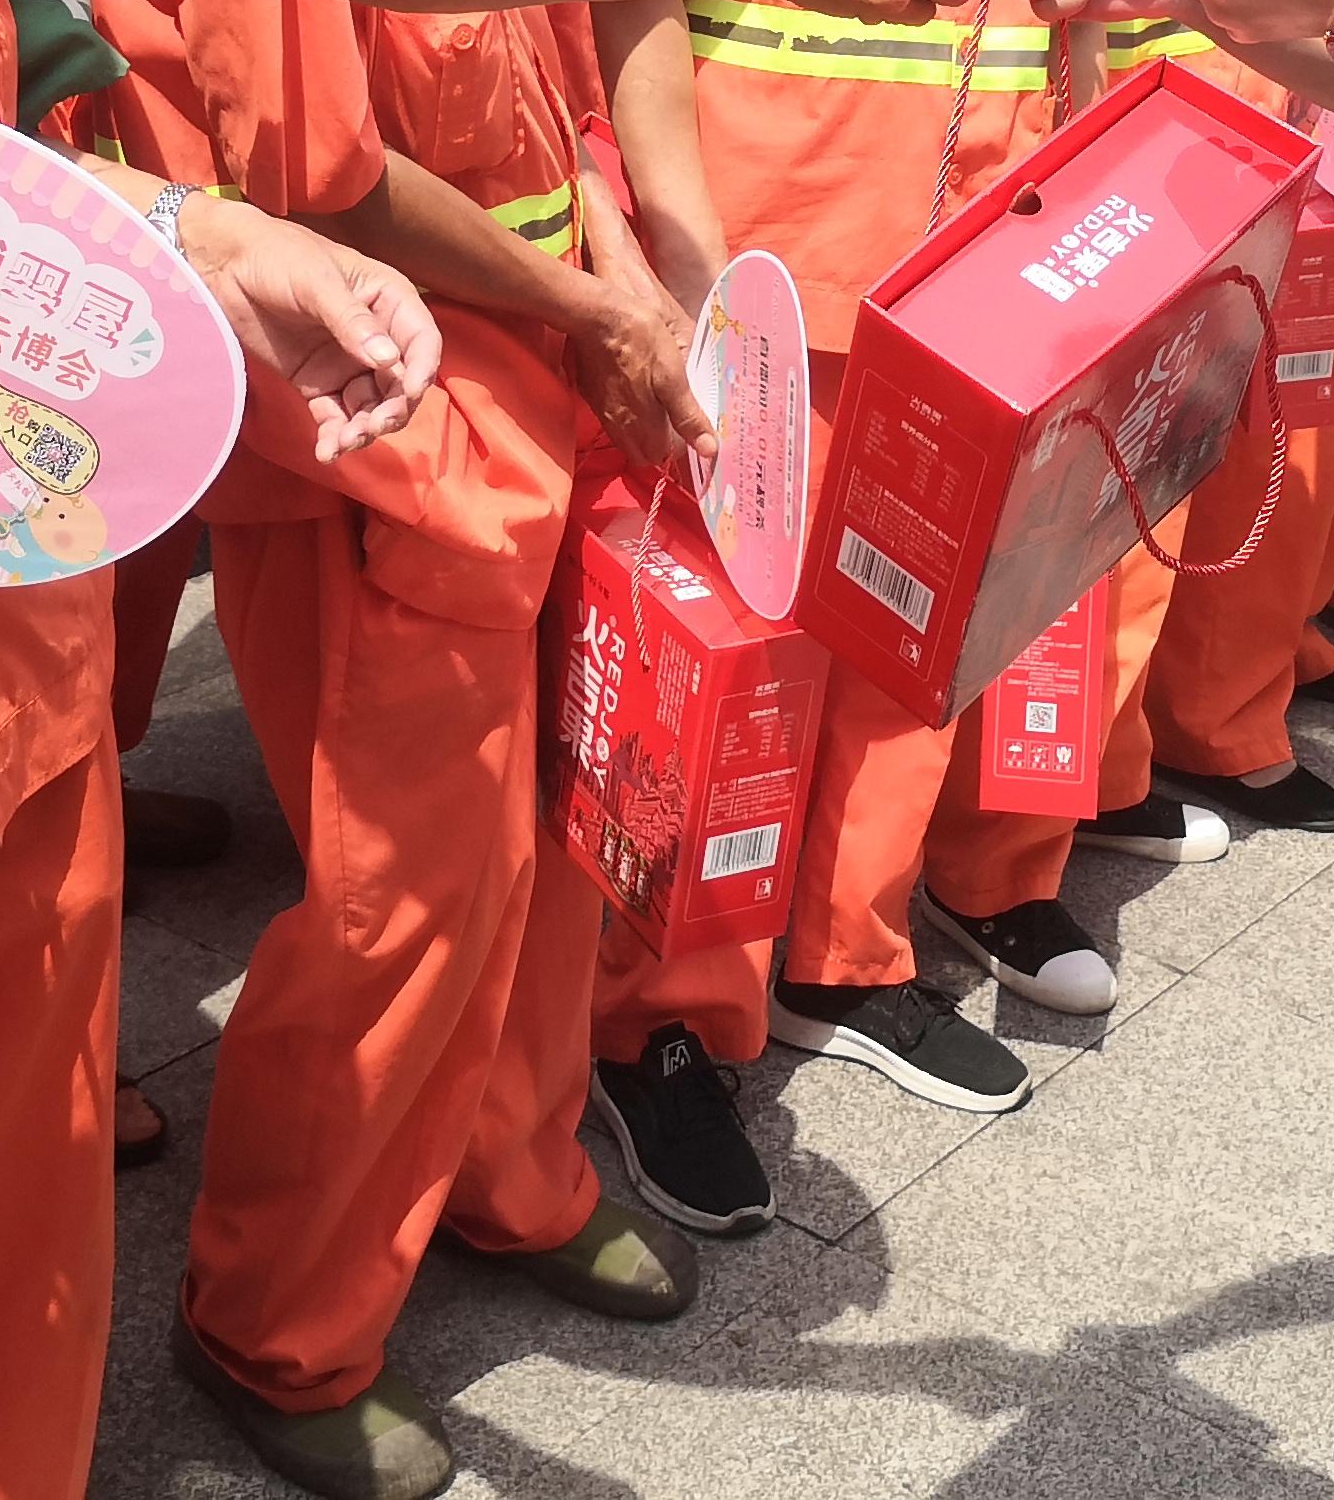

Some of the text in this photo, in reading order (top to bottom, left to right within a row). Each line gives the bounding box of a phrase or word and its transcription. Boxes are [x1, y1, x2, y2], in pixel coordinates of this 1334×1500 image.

[1051, 194, 1128, 260] REDJOY
[1067, 204, 1155, 279] 火吉果
[4, 425, 33, 447] 入口
[560, 598, 609, 772] 火吉果
[591, 631, 626, 790] REDJOY
